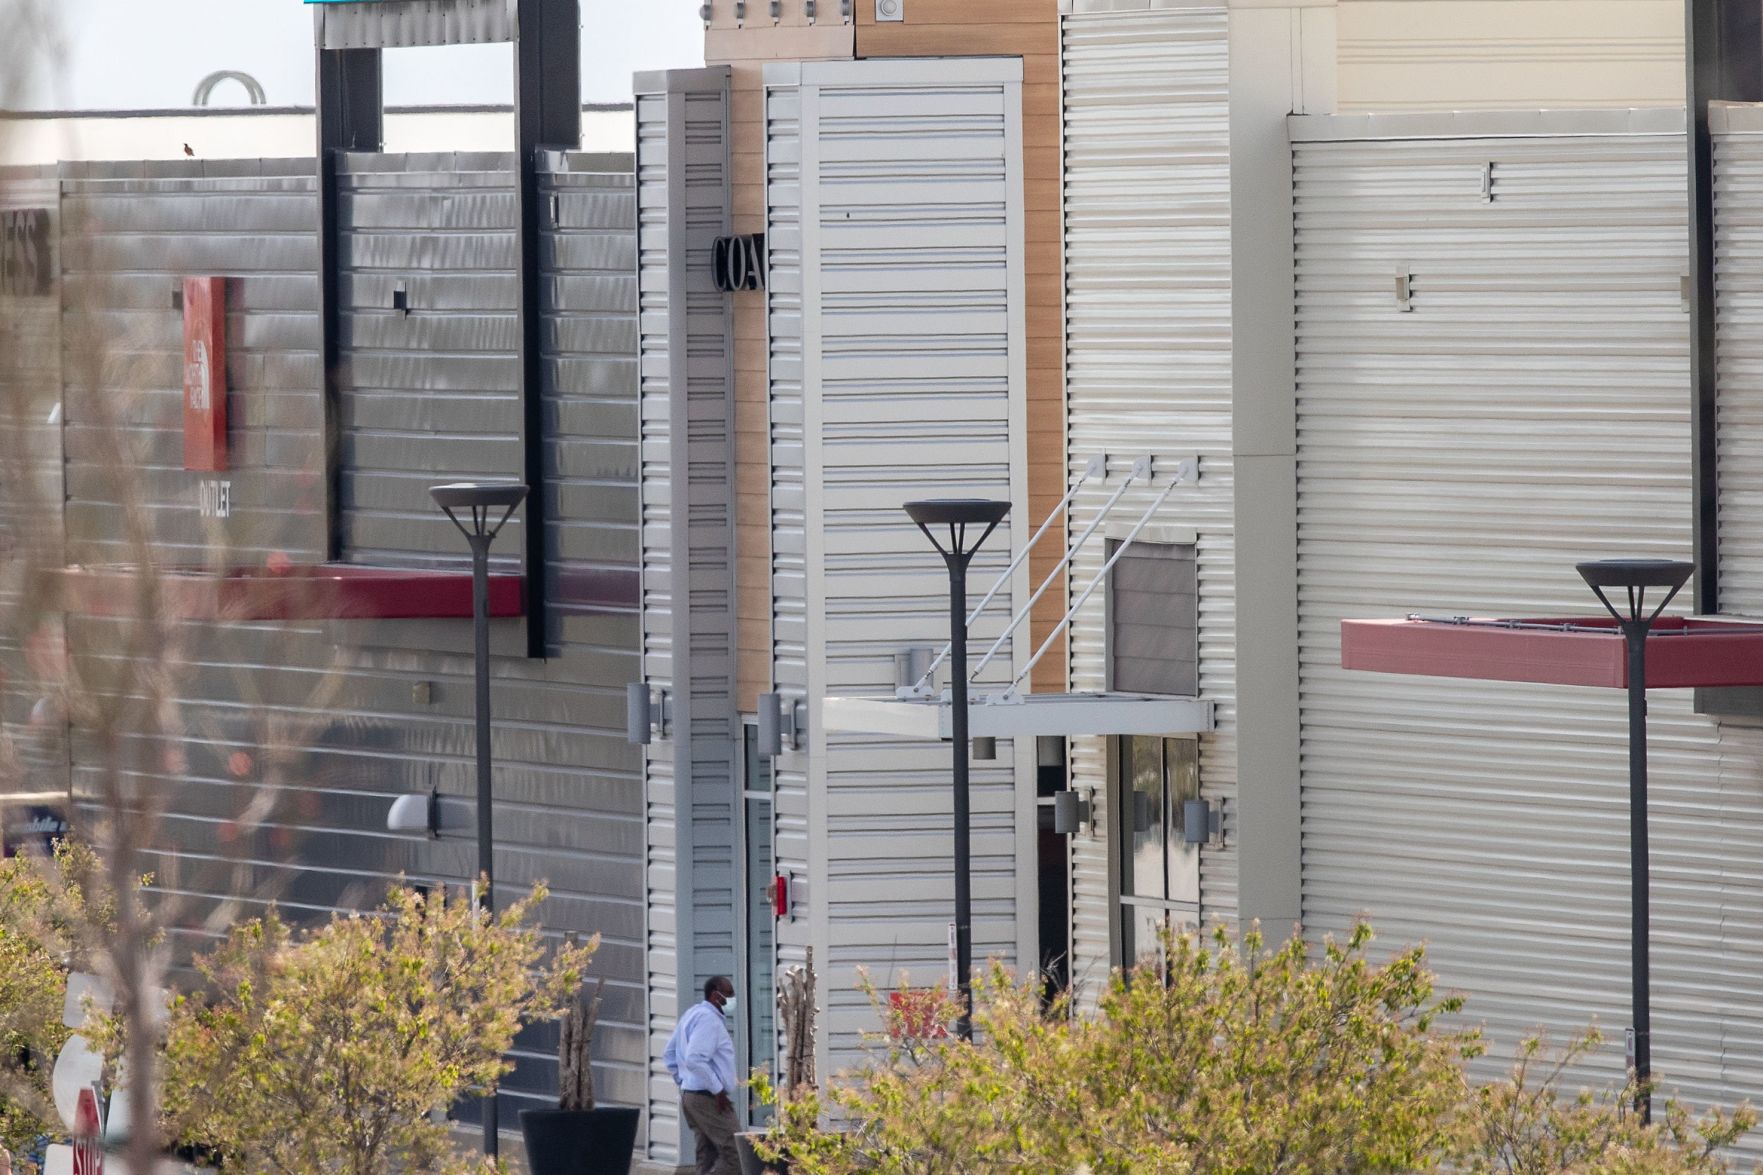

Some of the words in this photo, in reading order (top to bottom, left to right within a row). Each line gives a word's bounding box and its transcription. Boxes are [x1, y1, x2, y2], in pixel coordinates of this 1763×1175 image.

[0, 209, 39, 296] ESS
[711, 234, 765, 291] COA
[200, 480, 231, 517] OUTLET
